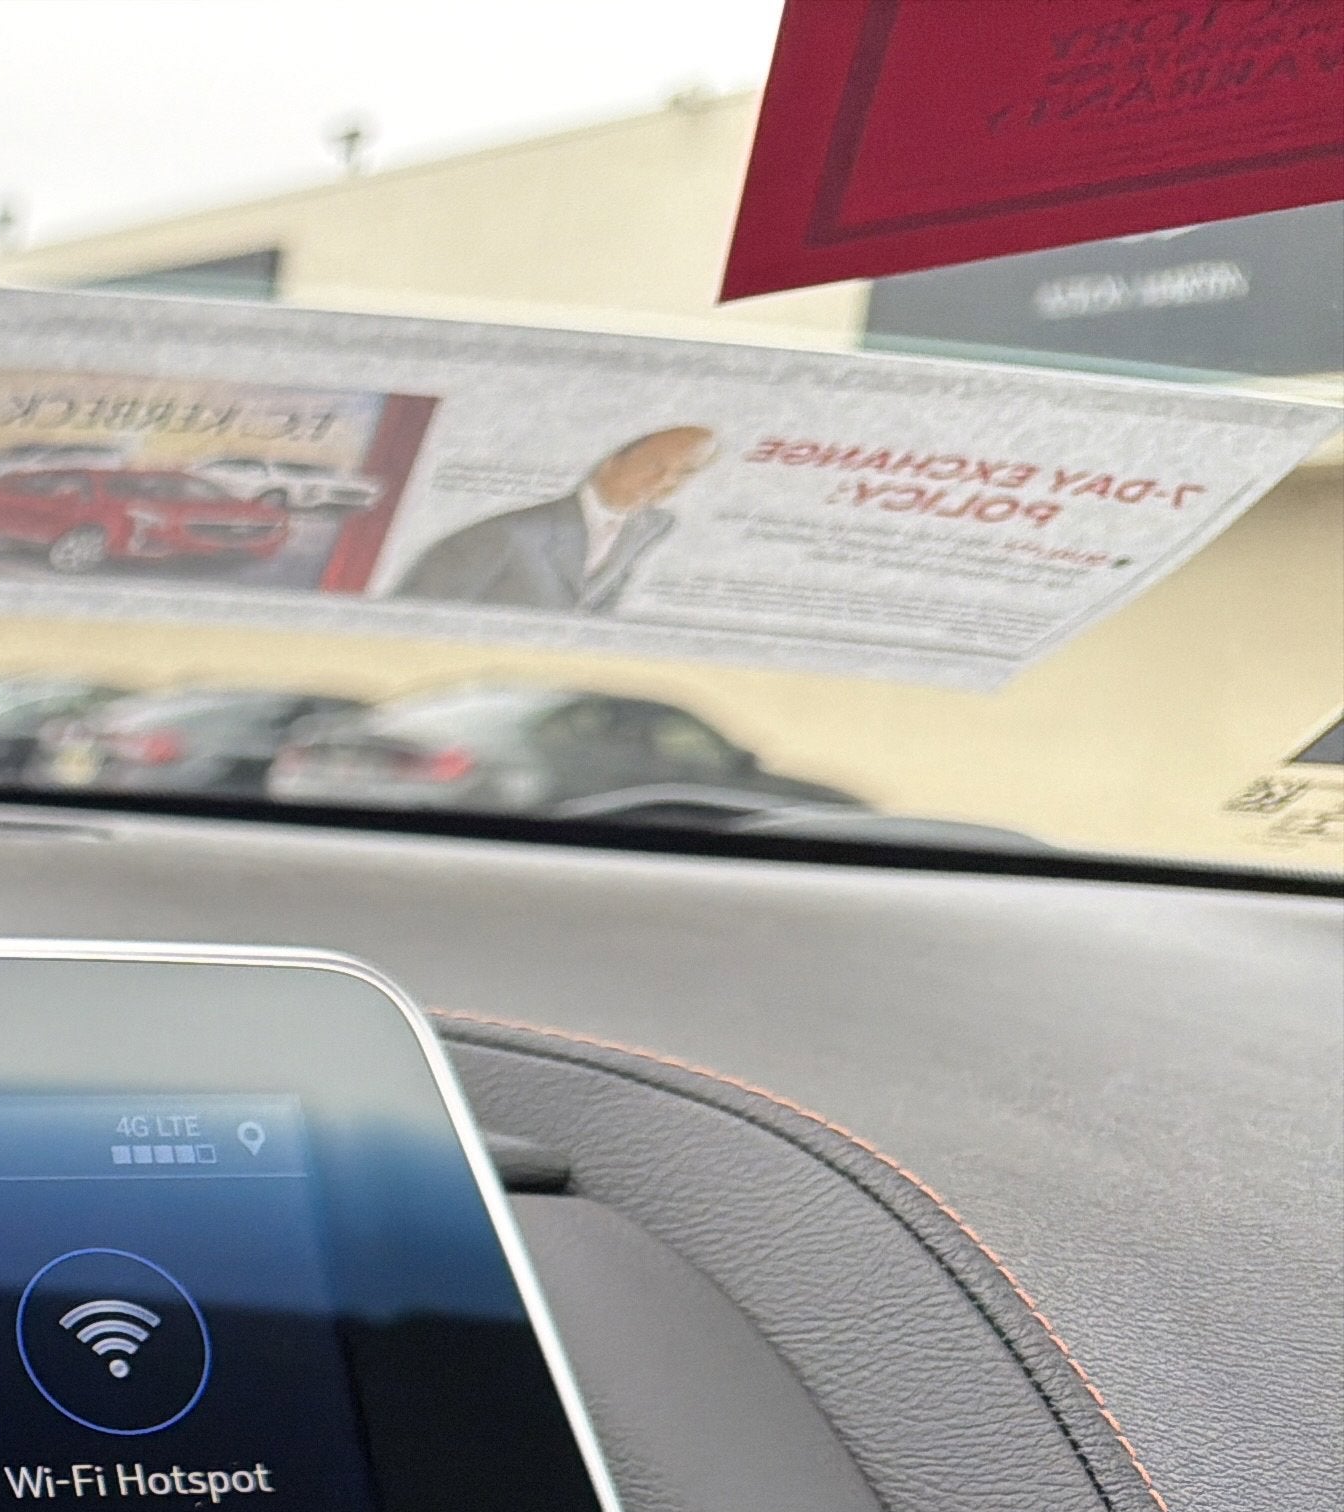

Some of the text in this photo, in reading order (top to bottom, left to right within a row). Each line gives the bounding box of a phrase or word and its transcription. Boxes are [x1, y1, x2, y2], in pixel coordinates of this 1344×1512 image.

[116, 1115, 201, 1137] 4G LTE
[4, 1462, 275, 1503] Wi-Fi Hotspot
